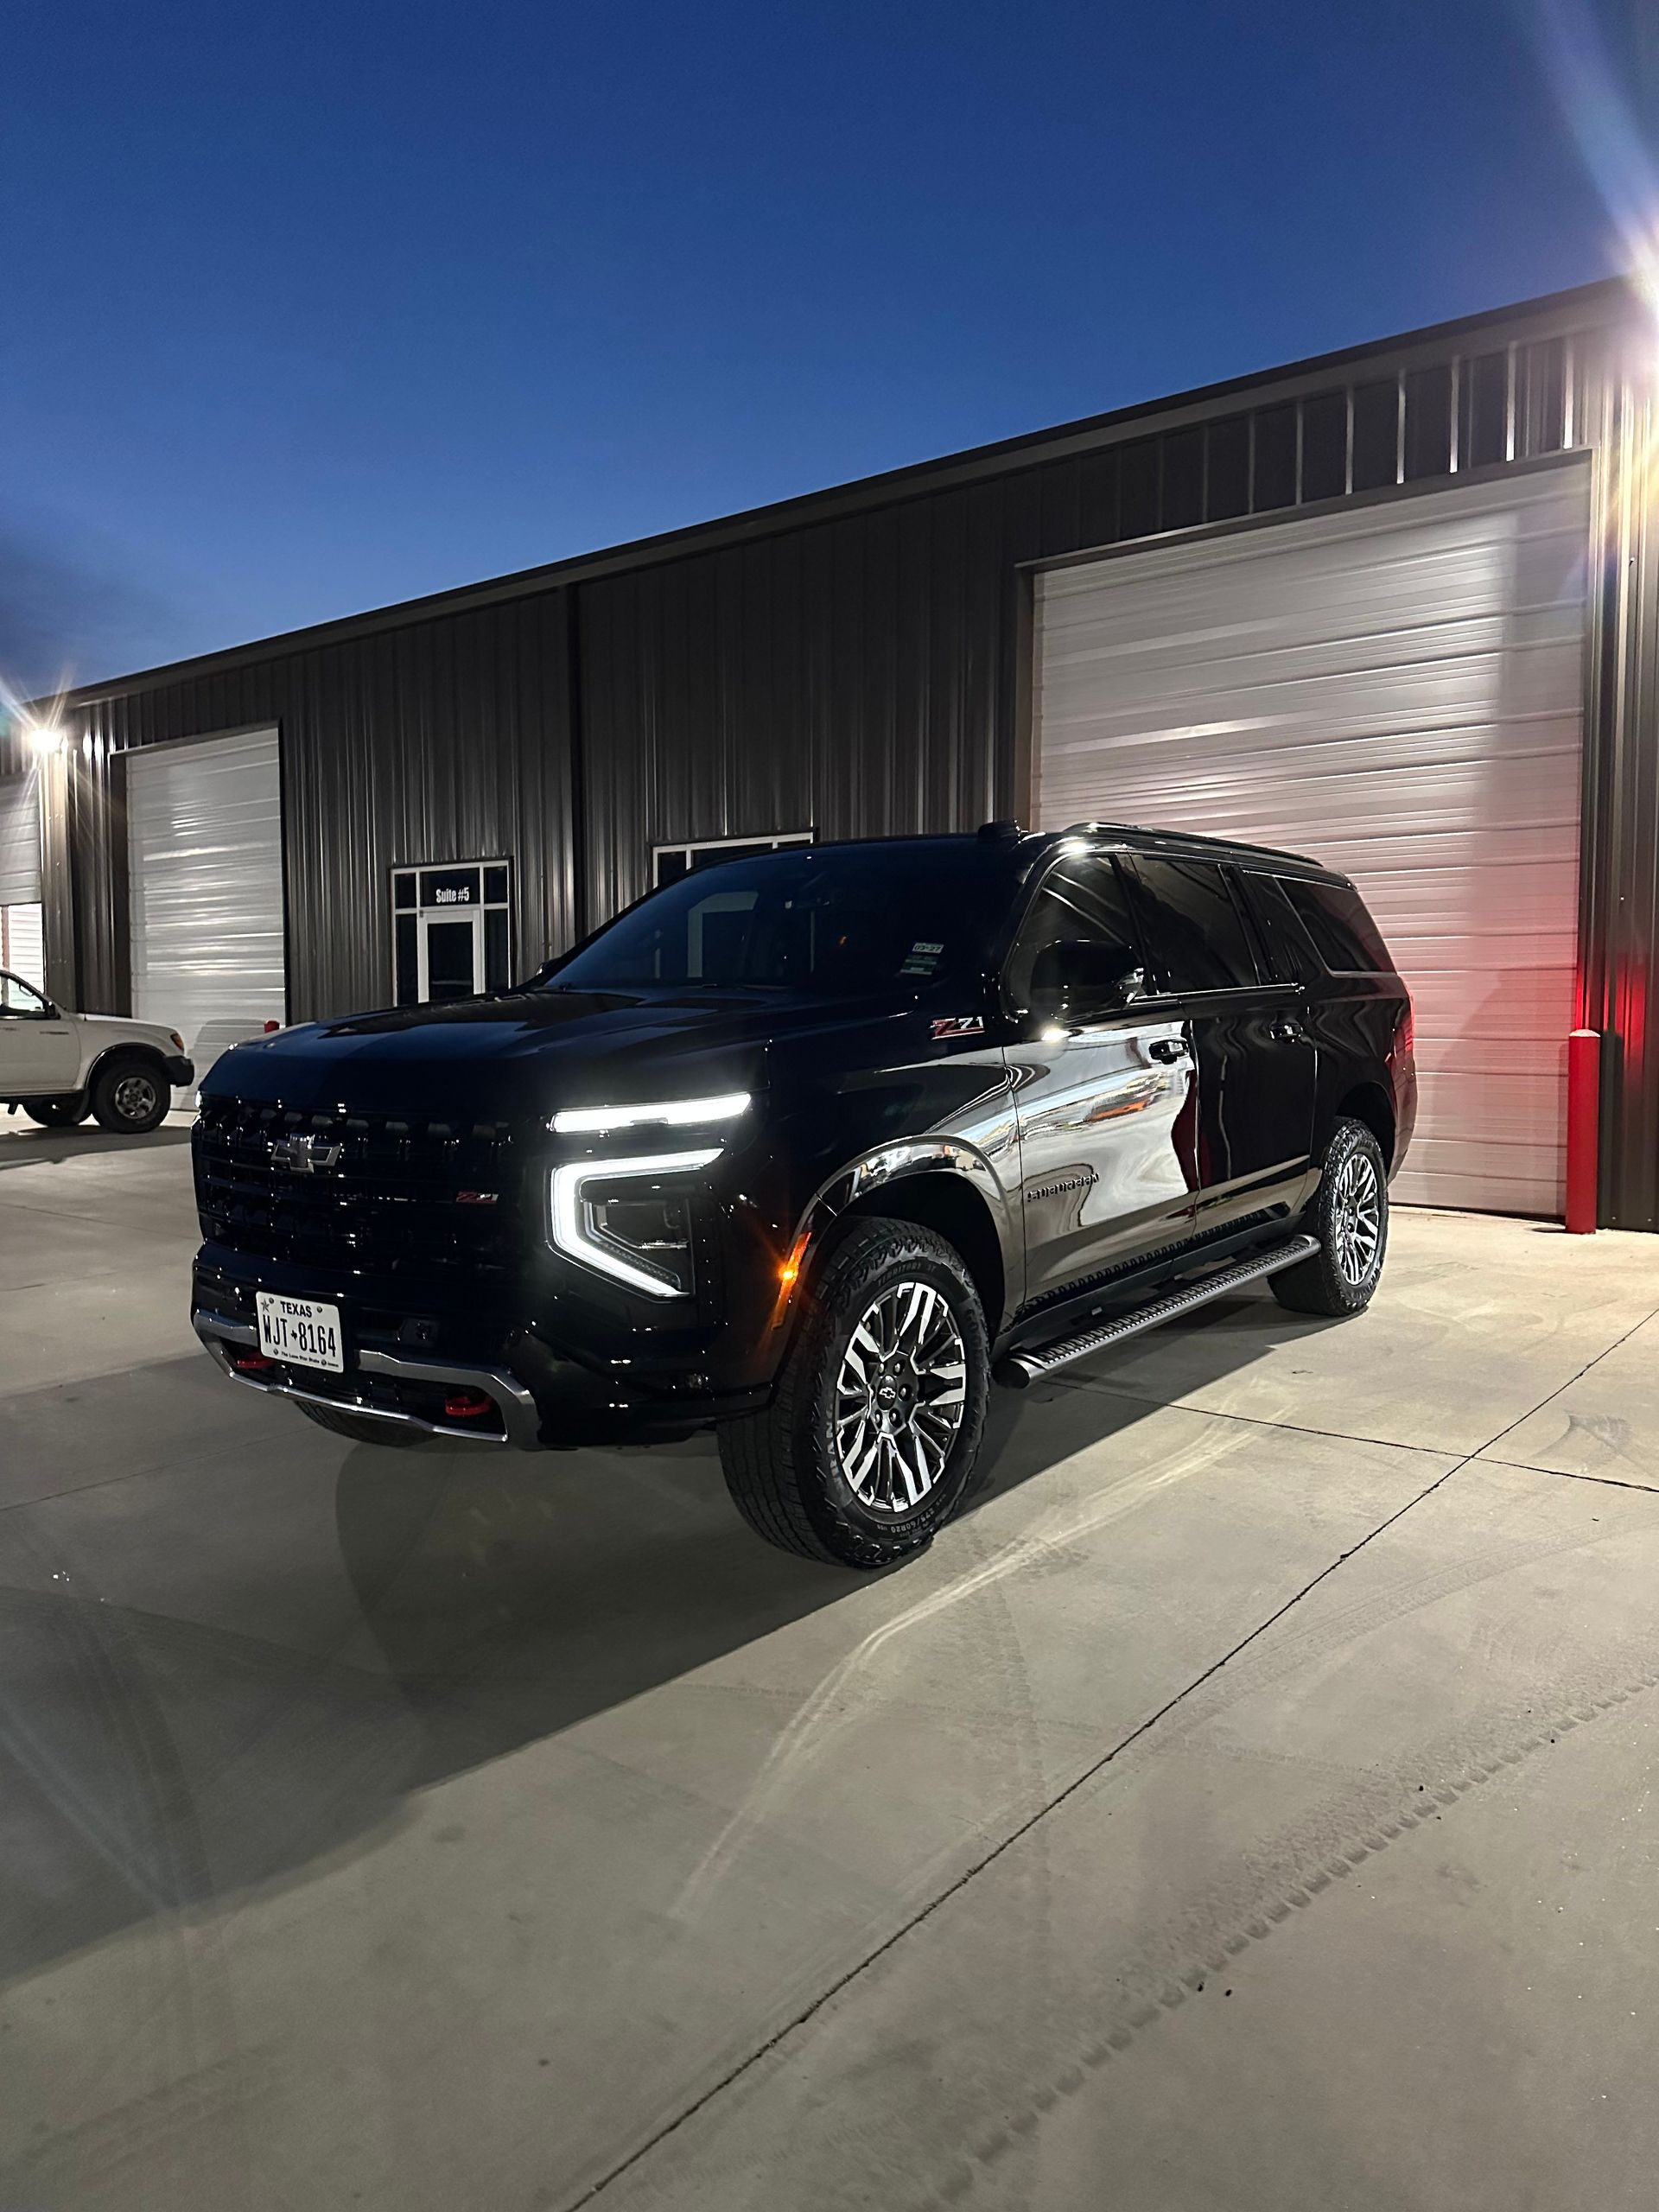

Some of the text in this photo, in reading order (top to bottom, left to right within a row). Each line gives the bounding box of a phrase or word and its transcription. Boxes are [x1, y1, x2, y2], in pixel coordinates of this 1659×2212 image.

[435, 887, 470, 903] Suite #5
[929, 1016, 985, 1040] Z71
[279, 1300, 312, 1319] TEXAS
[298, 1321, 336, 1357] 8164
